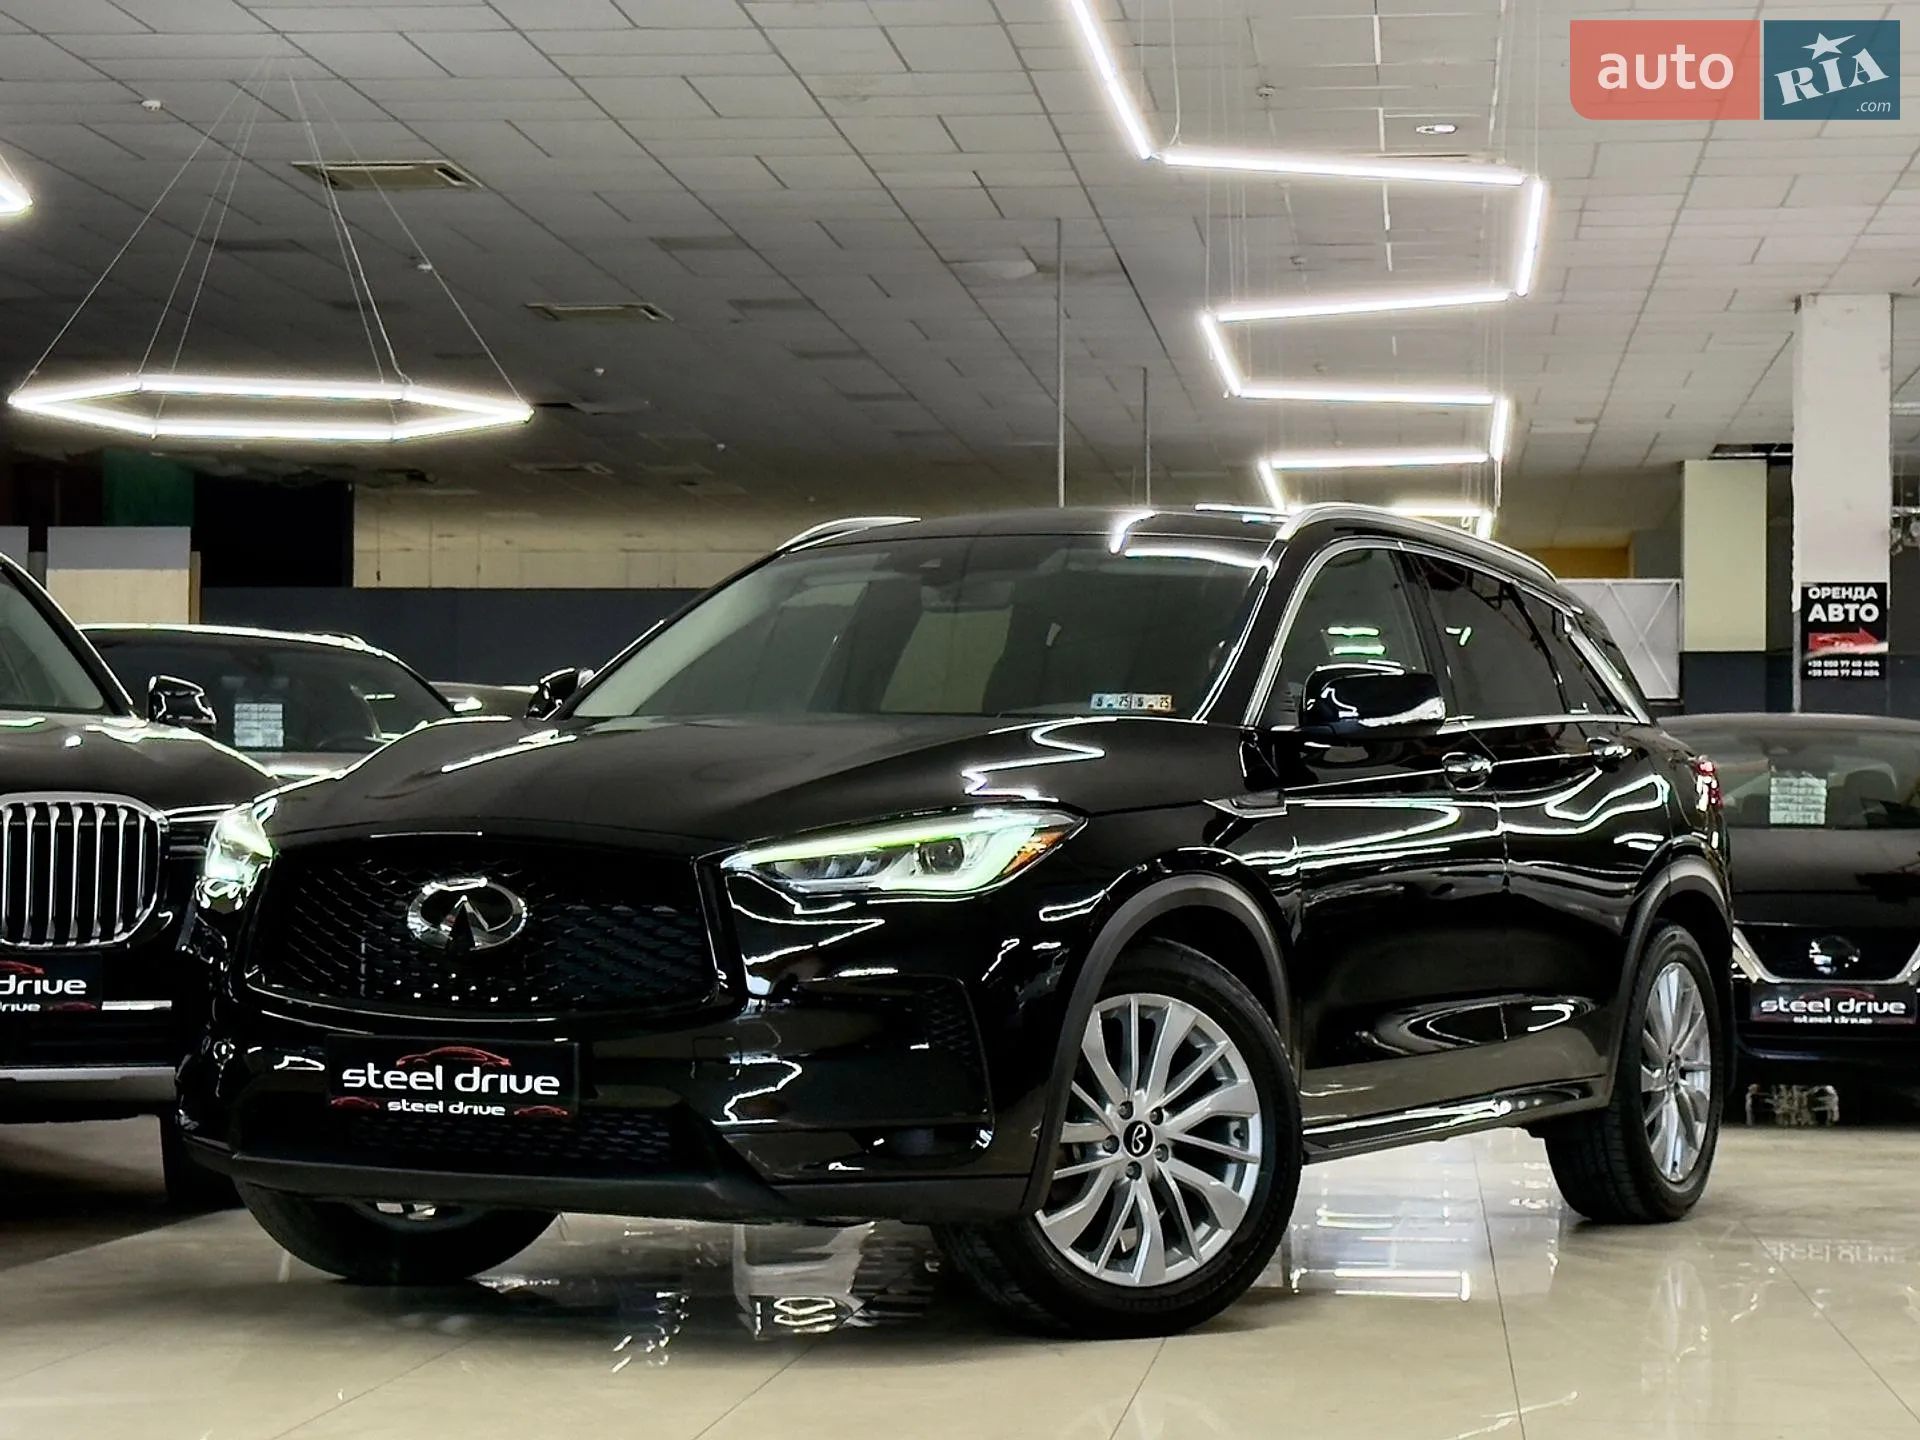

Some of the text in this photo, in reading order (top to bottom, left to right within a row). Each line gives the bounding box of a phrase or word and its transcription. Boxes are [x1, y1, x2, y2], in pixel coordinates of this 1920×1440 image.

[1808, 586, 1878, 601] ОРЕНДА
[1808, 603, 1879, 622] АВТО
[0, 974, 87, 995] drive
[0, 1001, 41, 1012] rive
[1760, 996, 1906, 1014] steel drive
[1793, 1015, 1832, 1024] steel
[342, 1062, 560, 1095] steel drive
[387, 1098, 506, 1116] steel drive
